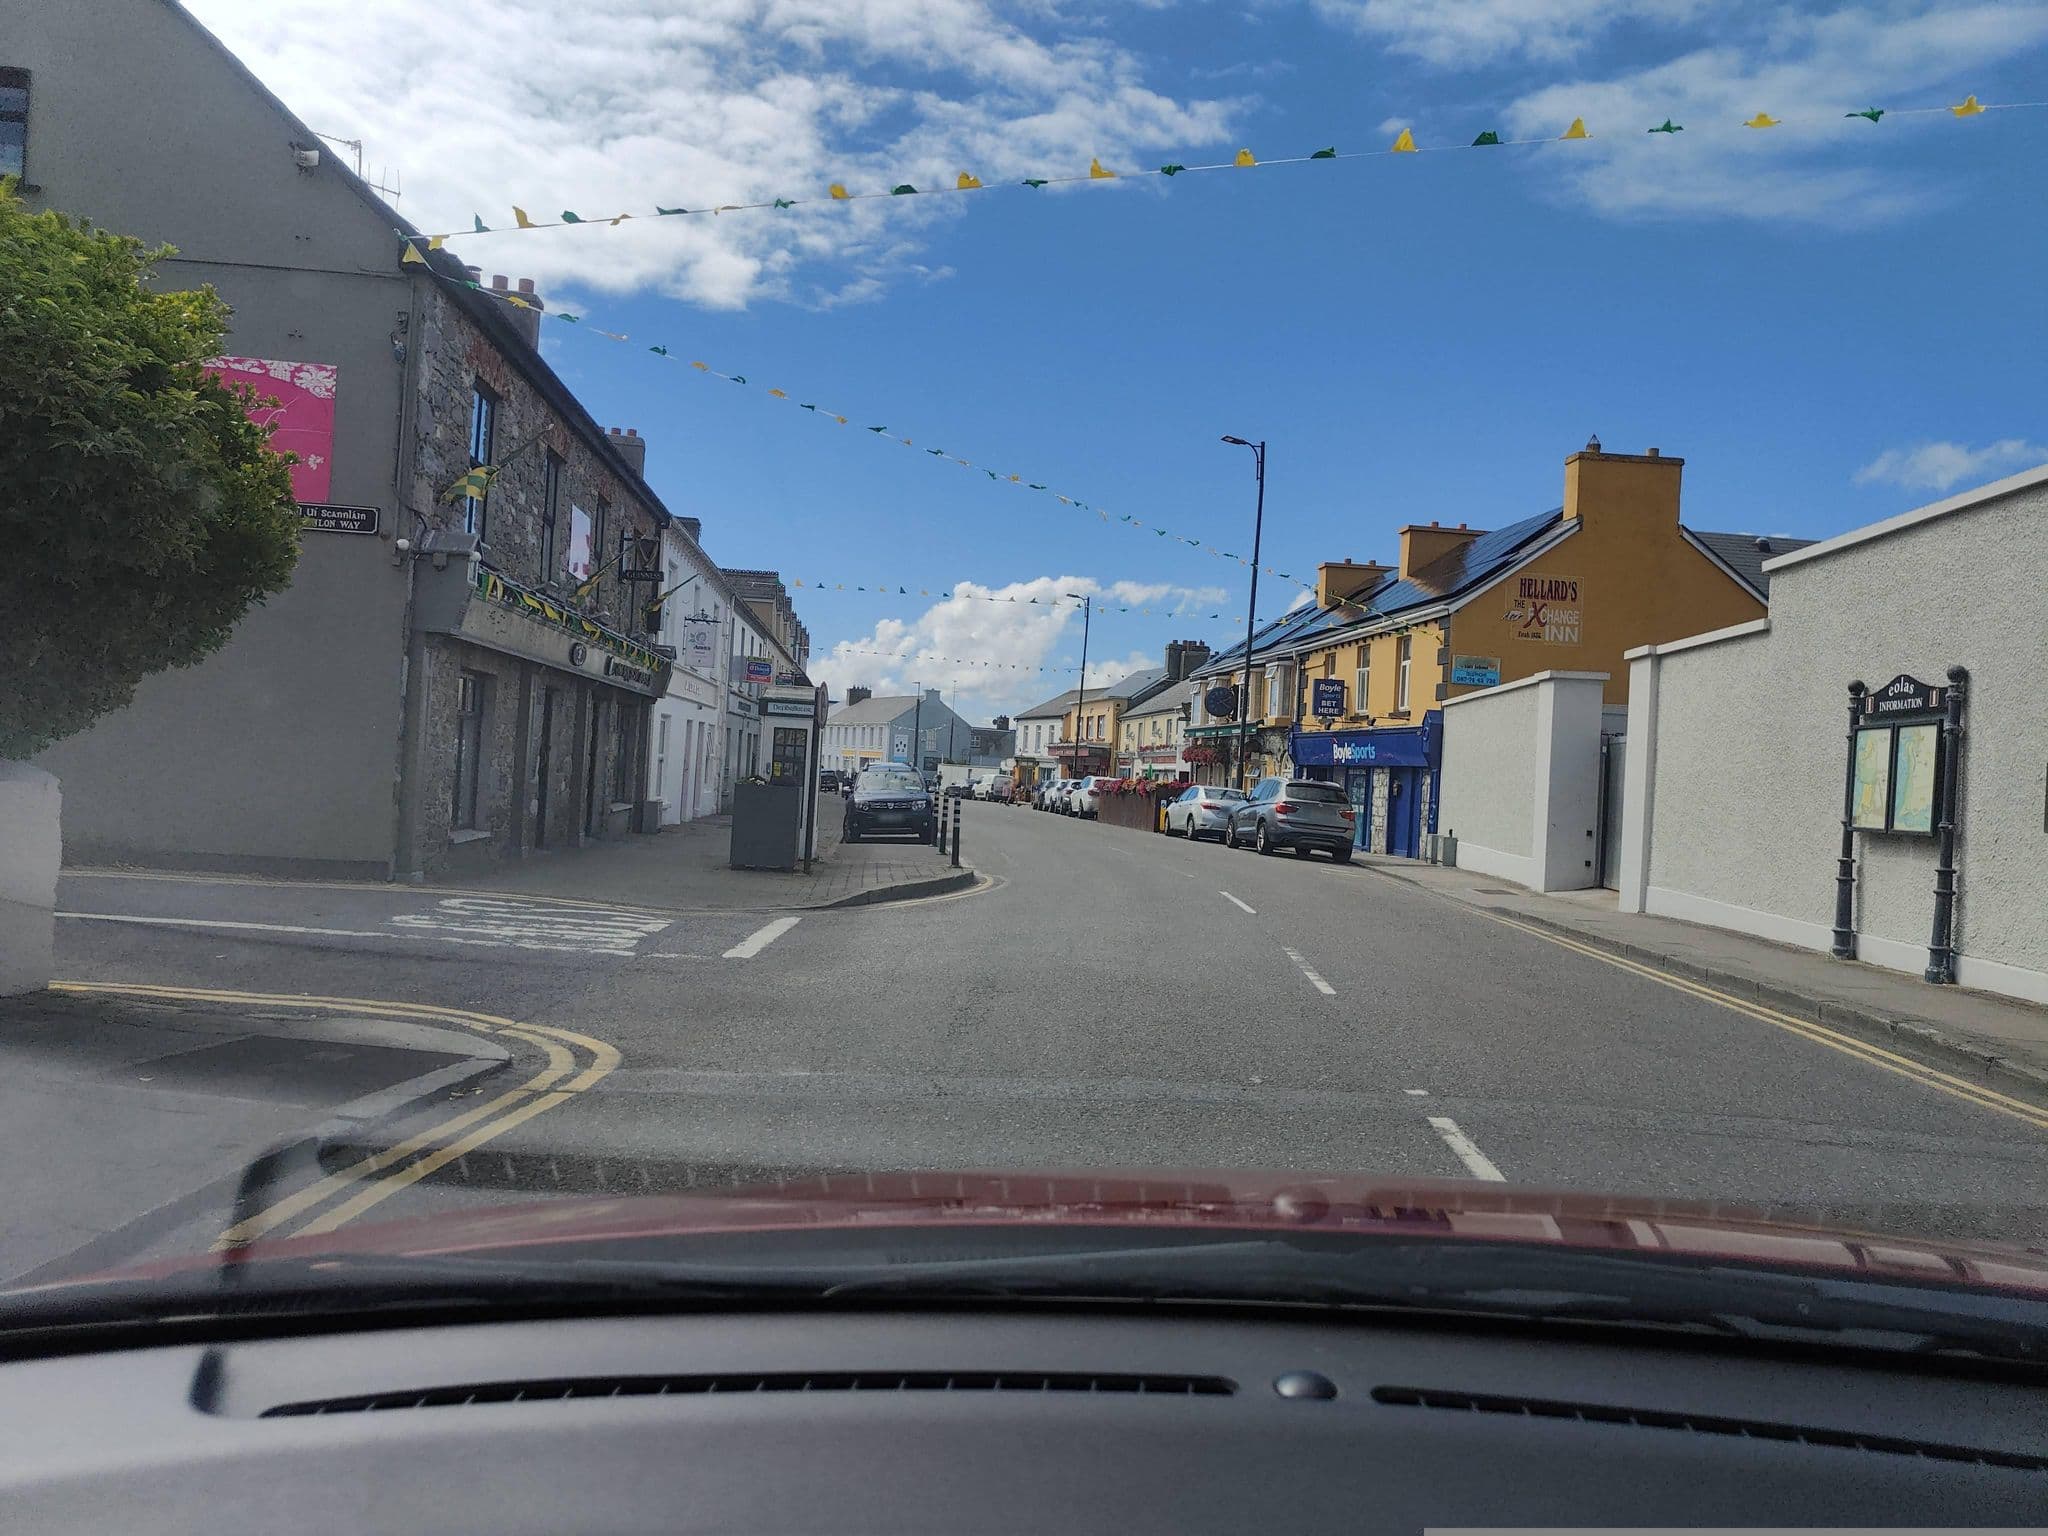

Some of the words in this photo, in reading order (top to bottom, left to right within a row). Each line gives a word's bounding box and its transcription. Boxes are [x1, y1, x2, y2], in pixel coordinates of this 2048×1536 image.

[341, 521, 360, 529] WAY
[1519, 577, 1577, 602] HELLARD'S
[1514, 599, 1525, 608] THE
[1544, 624, 1579, 643] INN
[1319, 684, 1342, 693] Boyle
[1888, 676, 1914, 696] eolas
[1879, 698, 1923, 712] INFORMATION
[1333, 742, 1375, 764] BoyleSports
